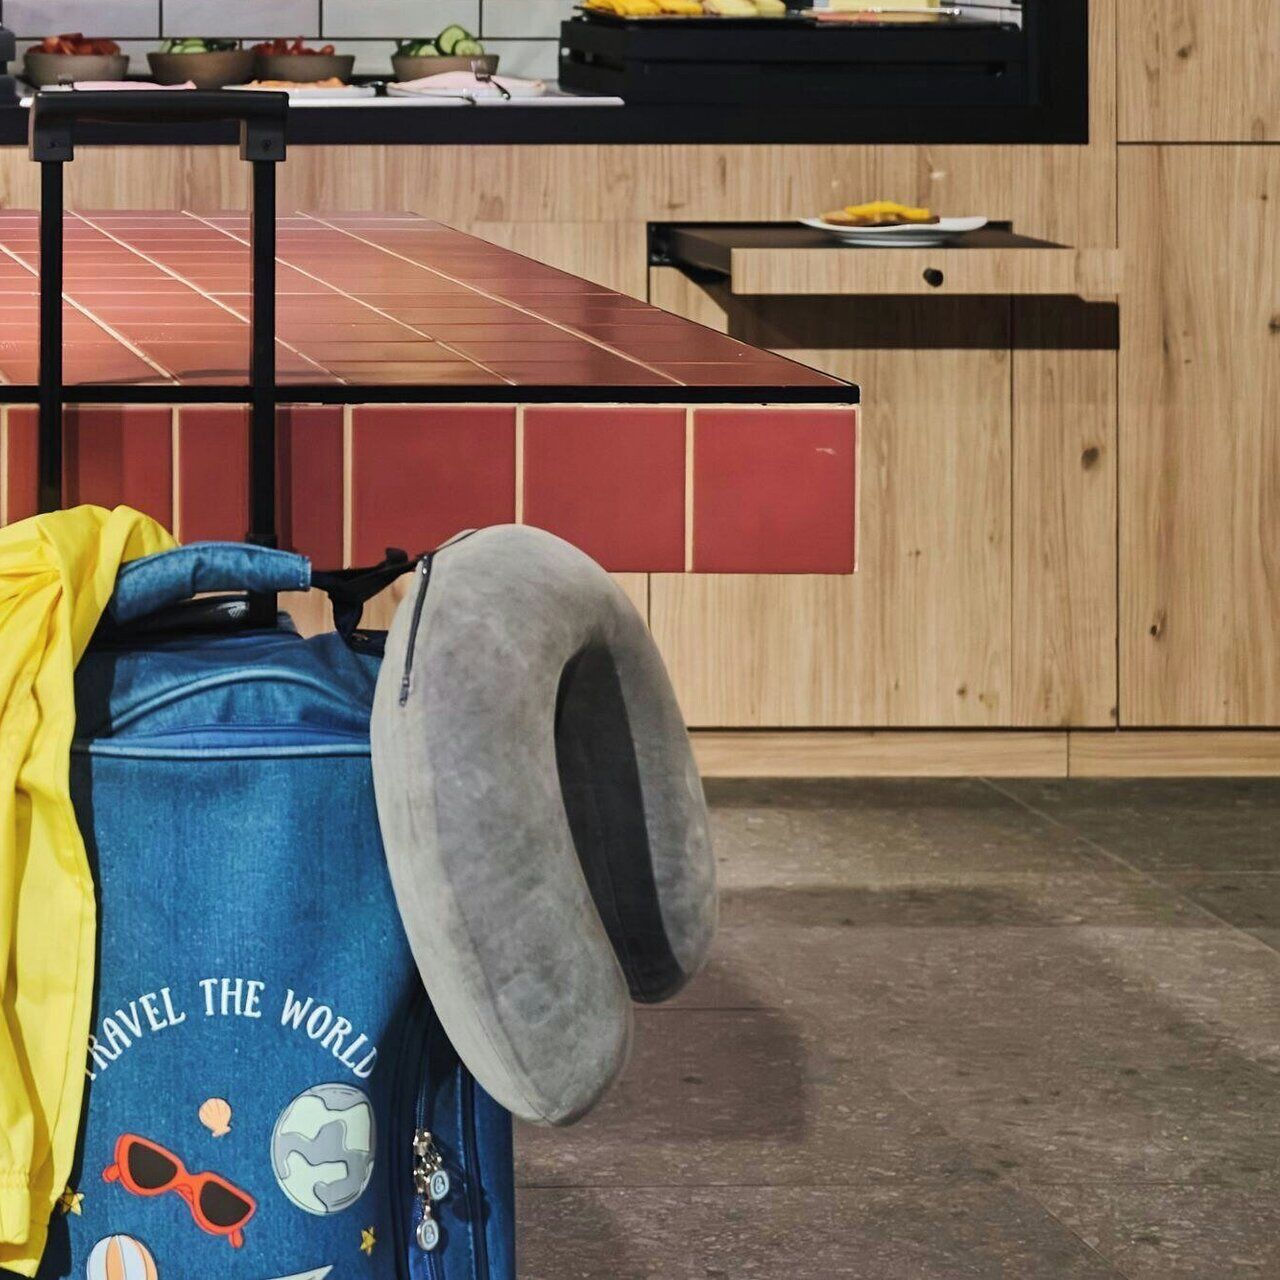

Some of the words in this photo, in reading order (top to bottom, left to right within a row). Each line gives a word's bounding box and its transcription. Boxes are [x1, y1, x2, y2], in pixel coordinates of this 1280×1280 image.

[85, 986, 187, 1081] RAVEL
[198, 977, 266, 1018] THE
[280, 988, 378, 1079] WORLD
